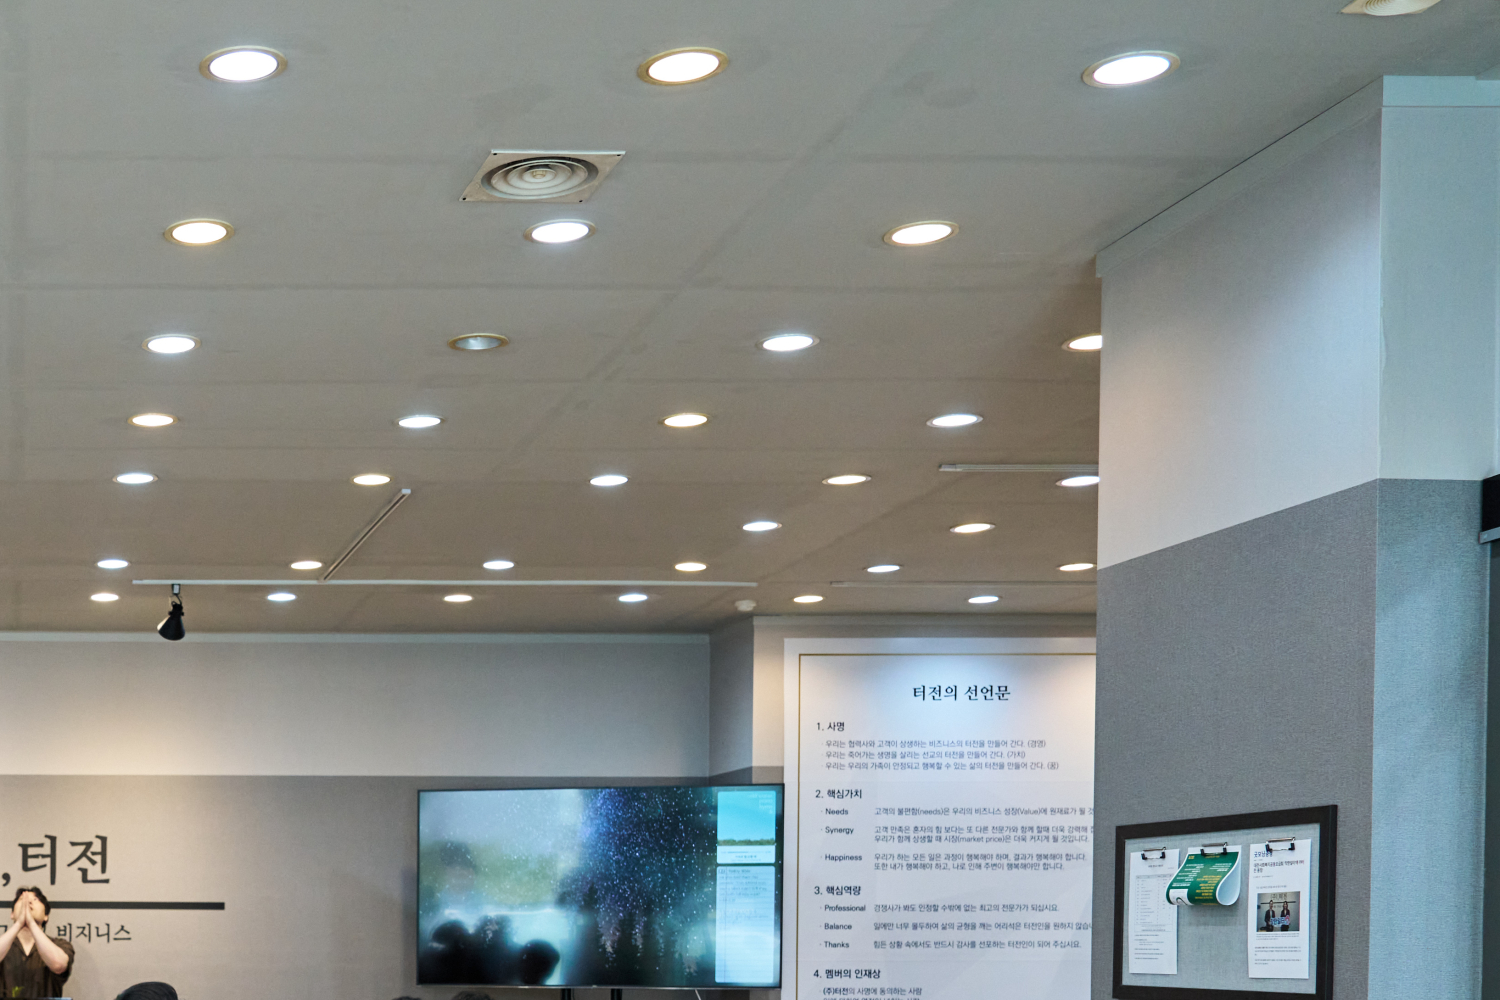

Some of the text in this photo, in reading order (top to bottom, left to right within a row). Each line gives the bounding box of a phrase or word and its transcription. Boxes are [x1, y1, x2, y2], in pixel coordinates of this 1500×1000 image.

[913, 685, 1010, 701] 터전의 선언문
[817, 722, 845, 731] 1. 사명
[825, 740, 1047, 748] 우리는 협력사와 고객이 상생하는 비즈니스의 터전을 만들어 간다. (경영)
[825, 751, 846, 759] 우리는
[847, 751, 875, 759] 죽어가는
[877, 751, 897, 759] 생명을
[899, 751, 920, 759] 살리는
[922, 751, 943, 759] 선교의
[944, 751, 965, 759] 터전을
[966, 751, 988, 759] 만들어
[989, 751, 1005, 759] 간다.
[825, 762, 846, 770] 우리는
[848, 762, 869, 770] 우리의
[870, 762, 891, 770] 가족이
[892, 762, 920, 770] 안정되고
[922, 762, 943, 770] 행복할
[944, 762, 952, 770] 수
[953, 762, 967, 770] 있는
[969, 762, 983, 770] 삶의
[984, 762, 1005, 770] 터전을
[1007, 762, 1028, 770] 만들어
[1029, 762, 1045, 770] 간다.
[815, 789, 862, 799] 2. 핵심가치
[825, 826, 854, 835] Synergy
[890, 826, 910, 834] 만족은
[935, 826, 942, 834] 힘
[944, 826, 964, 834] 보다는
[975, 826, 989, 834] 다른
[991, 826, 1018, 834] 전문가와
[1020, 826, 1034, 834] 함께
[897, 835, 911, 843] 함께
[912, 835, 933, 843] 상생할
[934, 835, 942, 843] 때
[943, 835, 984, 843] 시장(market
[985, 835, 1012, 843] price)은
[1052, 835, 1059, 843] 될
[1061, 835, 1089, 843] 것입니다.
[824, 854, 863, 862] Happiness
[874, 853, 895, 861] 우리가
[1035, 853, 1063, 861] 행복해야
[1065, 853, 1087, 861] 합니다.
[814, 886, 861, 895] 3. 핵심역량
[902, 904, 916, 912] 봐도
[918, 904, 939, 912] 인정할
[941, 904, 962, 912] 수밖에
[963, 904, 977, 912] 없는
[1001, 904, 1029, 912] 전문가가
[956, 922, 977, 930] 균형을
[994, 922, 1022, 930] 어리석은
[1023, 922, 1051, 930] 터전인을
[1053, 922, 1074, 930] 원하지
[57, 923, 132, 943] 비지니스
[889, 941, 903, 949] 상황
[813, 969, 881, 979] 4. 멤버의 인재상
[823, 987, 855, 995] (주)터전의
